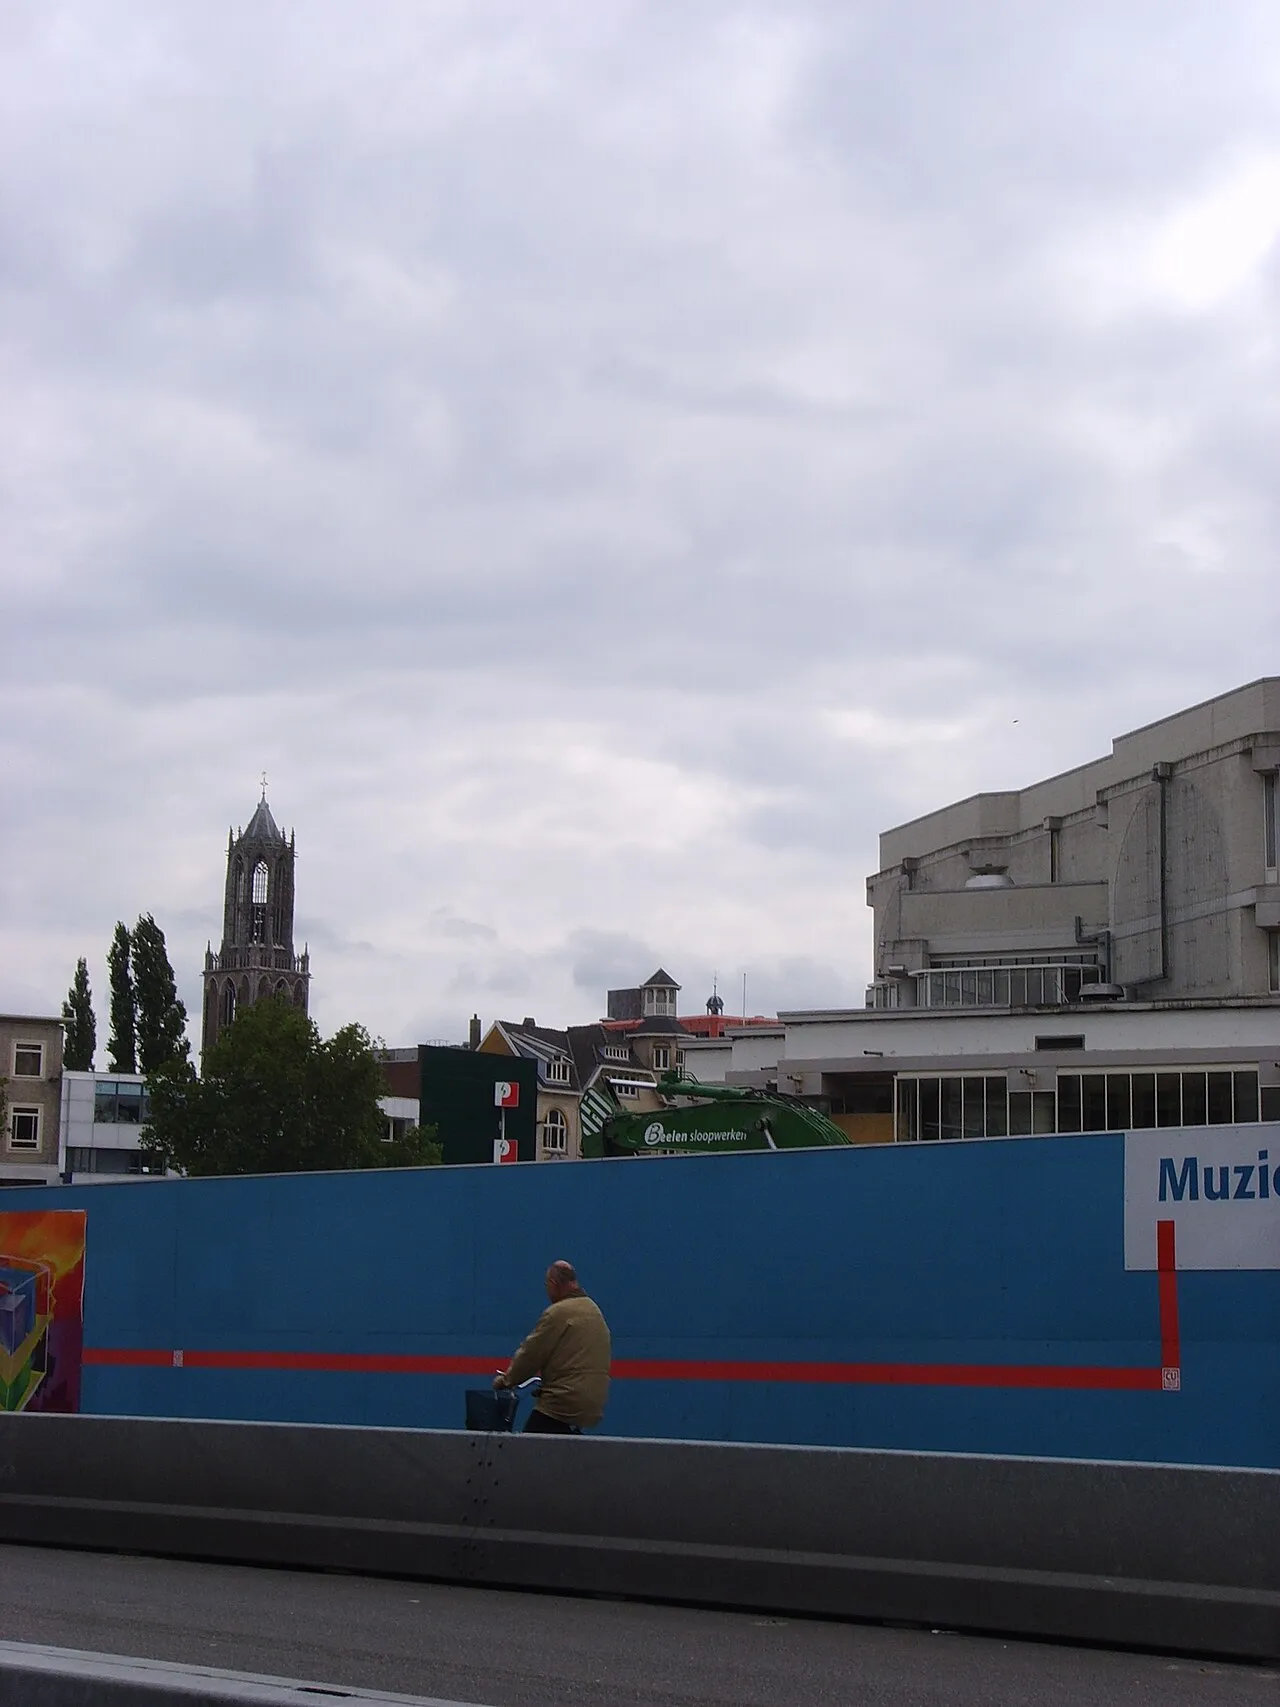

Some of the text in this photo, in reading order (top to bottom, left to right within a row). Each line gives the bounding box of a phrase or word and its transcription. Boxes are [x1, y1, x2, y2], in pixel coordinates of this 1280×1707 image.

[644, 1122, 747, 1146] Beelen sloopwerken
[1158, 1149, 1280, 1202] Muzi
